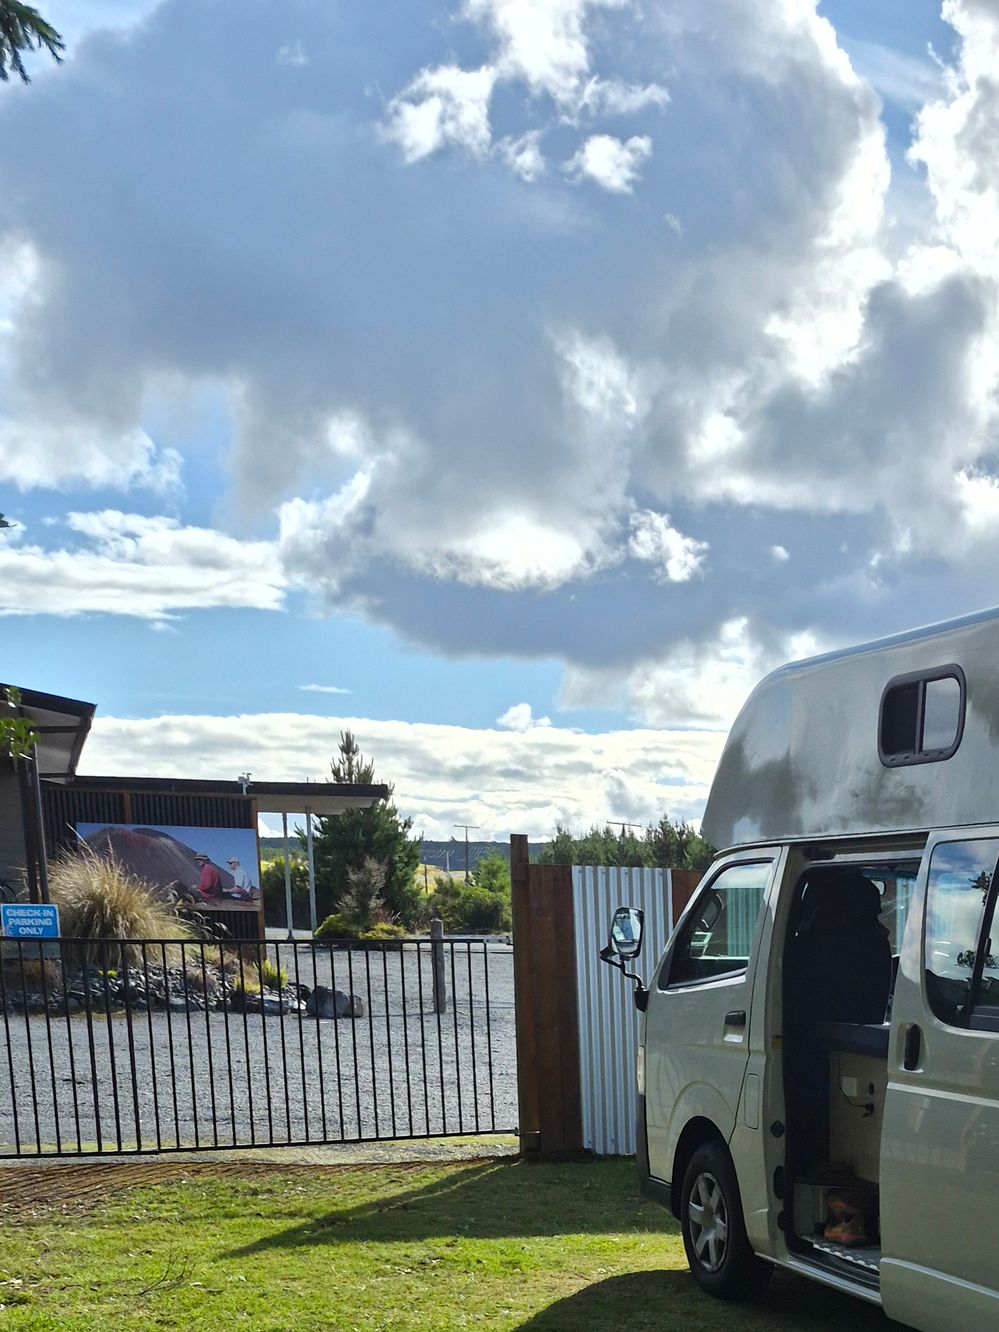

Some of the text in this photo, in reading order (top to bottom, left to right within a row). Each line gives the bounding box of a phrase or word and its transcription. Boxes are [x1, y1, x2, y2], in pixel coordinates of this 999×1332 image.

[6, 909, 54, 917] CHECK-IN
[8, 918, 52, 926] PARKING
[18, 926, 44, 935] ONLY
